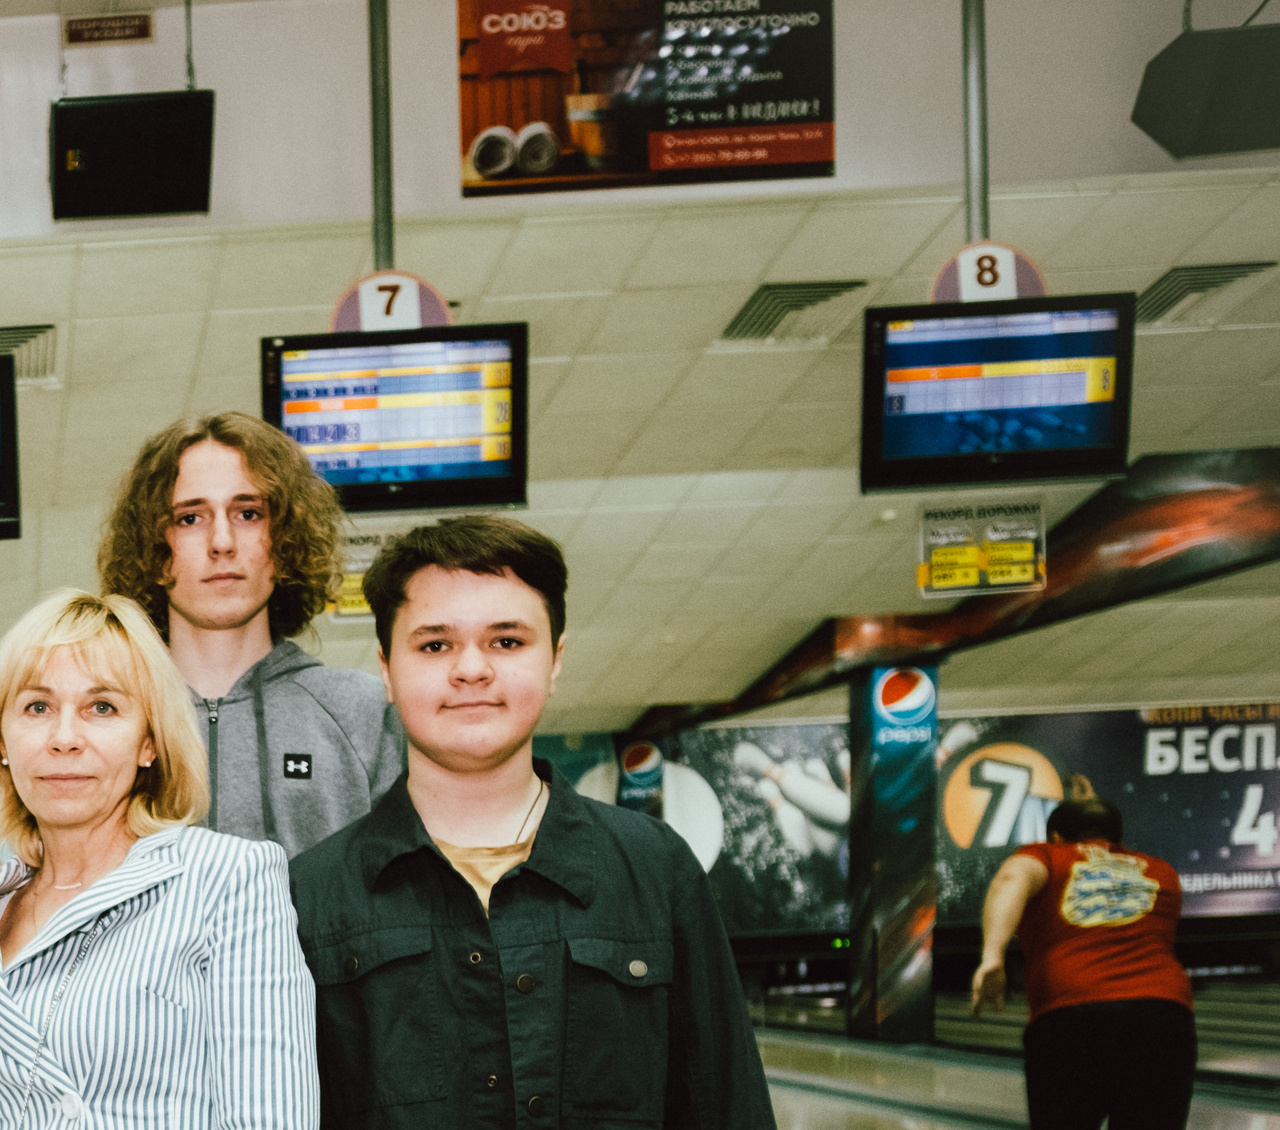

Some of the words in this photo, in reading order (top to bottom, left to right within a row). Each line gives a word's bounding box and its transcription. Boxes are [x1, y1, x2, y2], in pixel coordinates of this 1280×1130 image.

[481, 9, 567, 33] СОЮЗ
[976, 254, 1000, 288] 8
[376, 284, 401, 316] 7
[876, 726, 932, 745] pepsi
[1146, 723, 1280, 775] БЕСП
[981, 760, 1030, 848] 7
[1231, 783, 1278, 857] 4
[1180, 870, 1275, 893] ЕДЕЛЬНИКА
